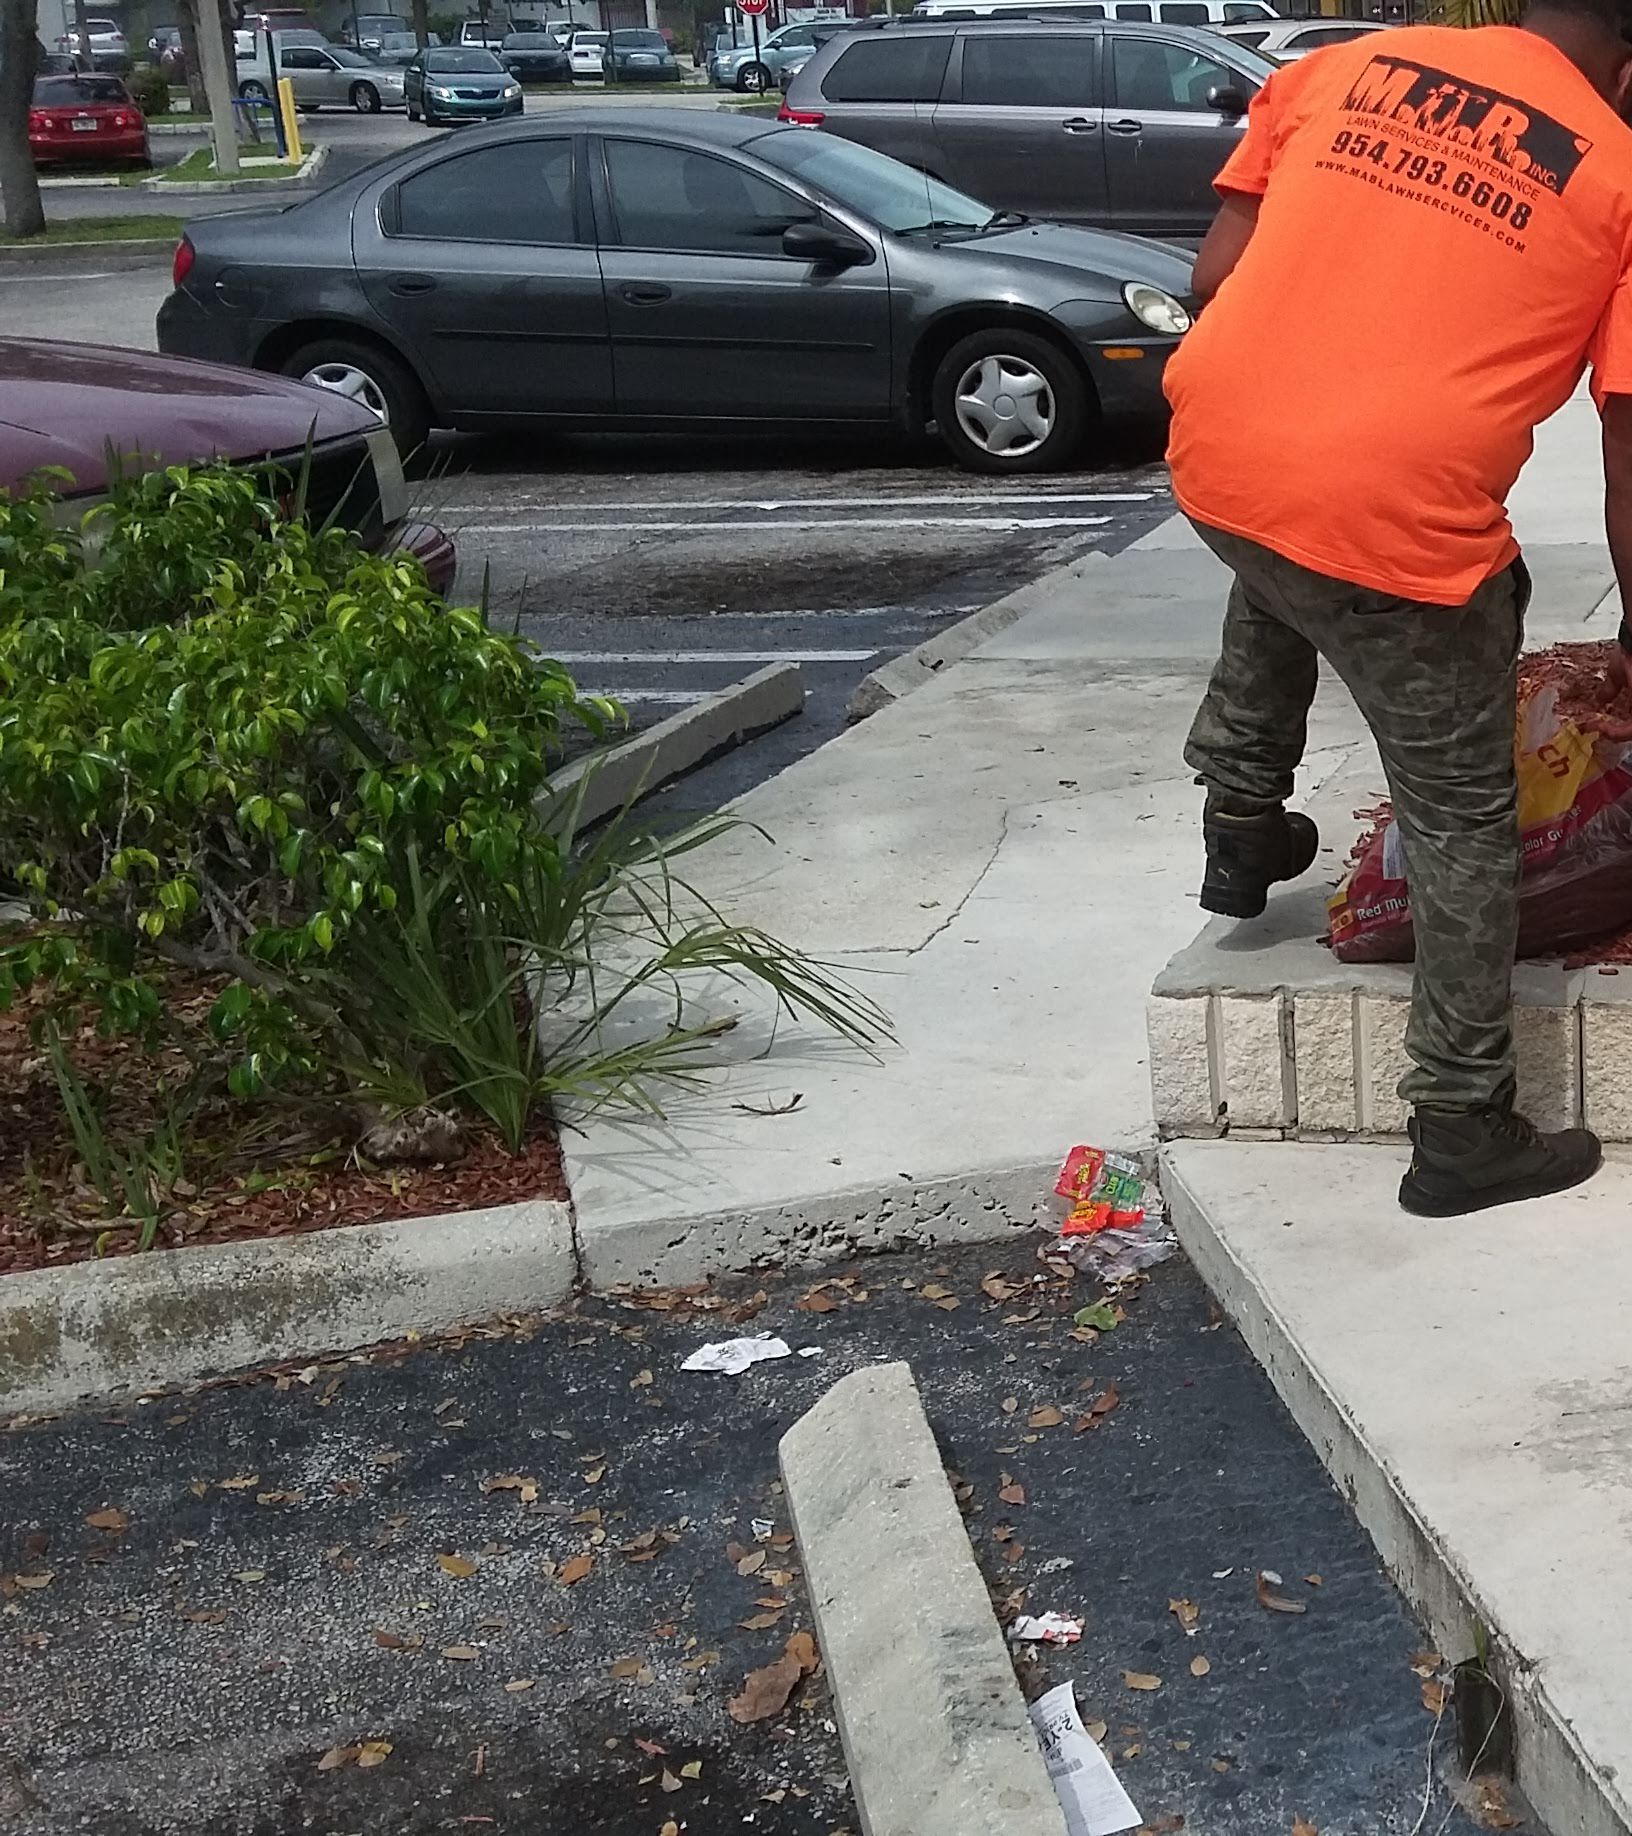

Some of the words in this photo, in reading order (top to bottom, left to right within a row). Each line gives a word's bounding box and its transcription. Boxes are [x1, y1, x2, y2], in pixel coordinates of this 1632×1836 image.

[1330, 130, 1534, 231] 954.793.6608
[1346, 115, 1381, 130] LAWN
[1380, 123, 1441, 153] SERVICES
[1440, 145, 1451, 156] &
[1450, 148, 1542, 202] MAINTENANCE
[1356, 904, 1382, 921] Red
